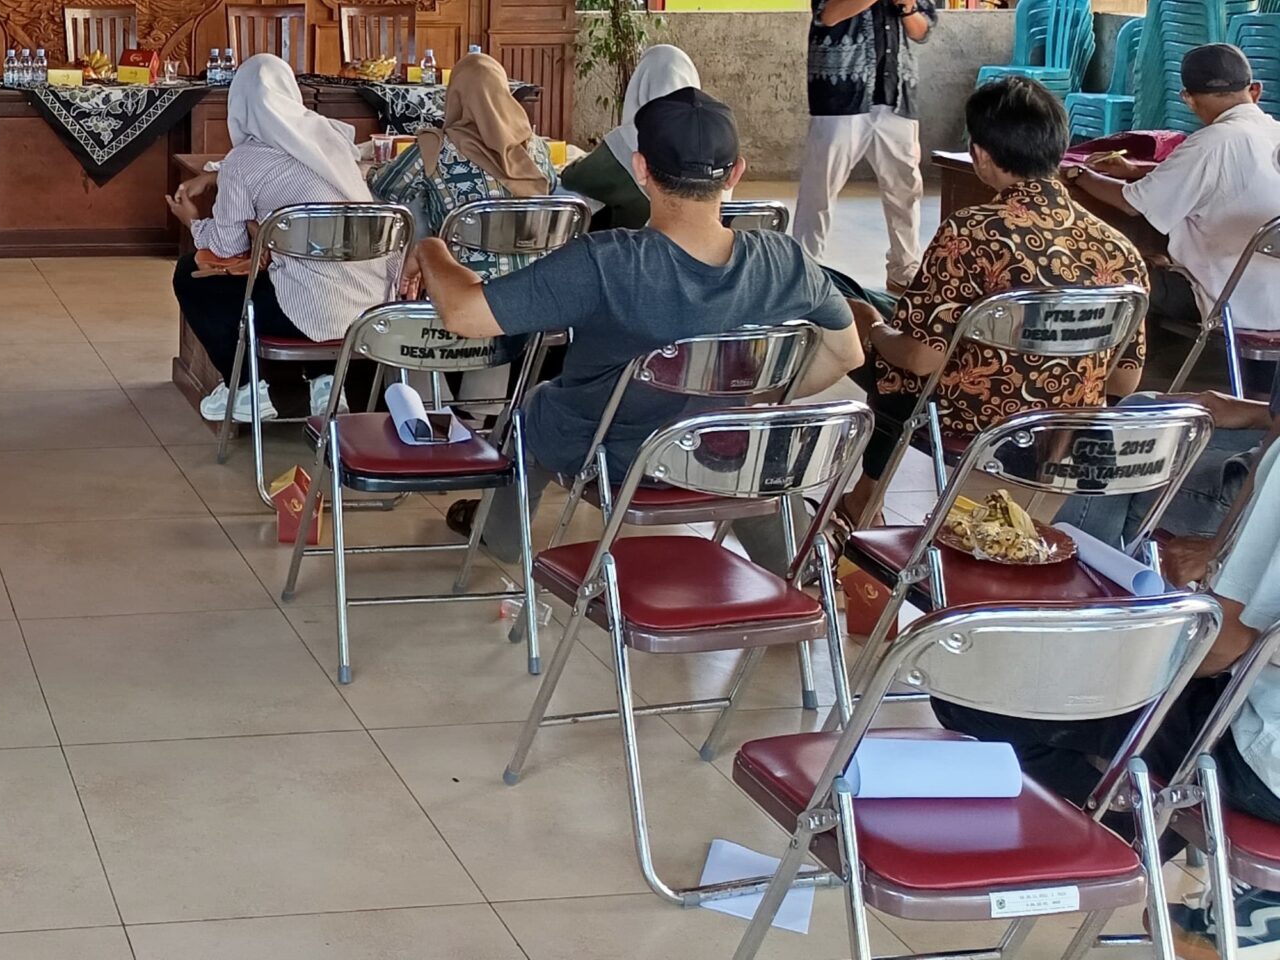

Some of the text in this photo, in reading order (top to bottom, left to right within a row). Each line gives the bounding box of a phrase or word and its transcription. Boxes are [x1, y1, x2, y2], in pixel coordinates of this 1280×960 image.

[421, 327, 453, 340] PTSL
[401, 344, 436, 359] DESA
[1073, 438, 1116, 457] PTSL
